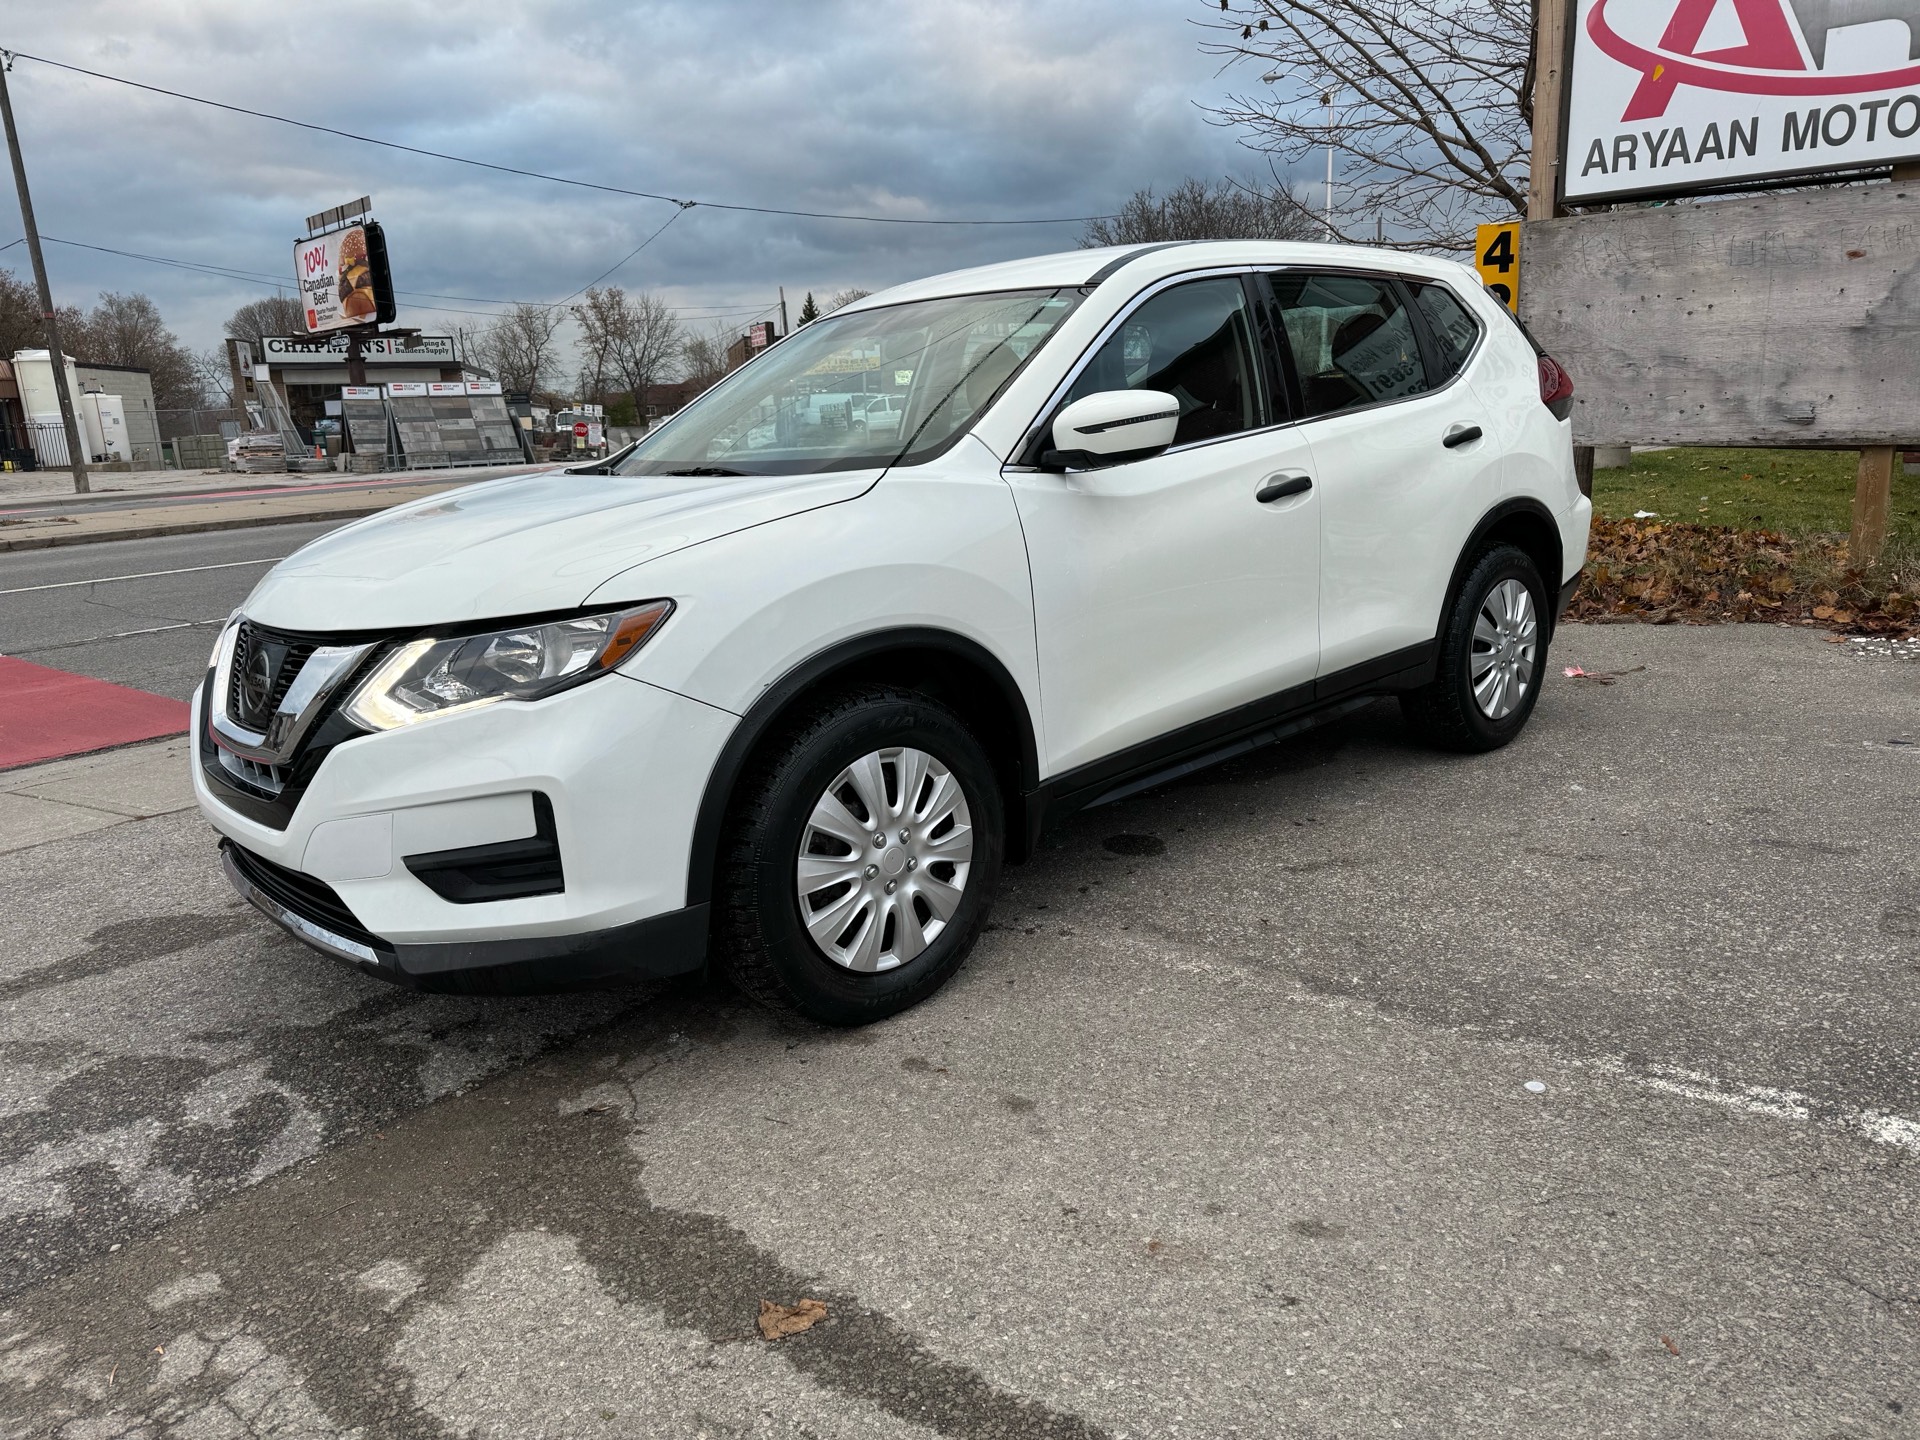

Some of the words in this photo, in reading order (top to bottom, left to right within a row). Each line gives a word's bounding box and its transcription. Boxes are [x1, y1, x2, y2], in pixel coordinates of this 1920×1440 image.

[1581, 117, 1759, 177] ARYAAN
[304, 243, 328, 278] 100%
[303, 274, 335, 293] Canadian
[313, 289, 329, 306] Beef
[268, 339, 385, 353] CHAPMN'S
[394, 340, 440, 348] Laping
